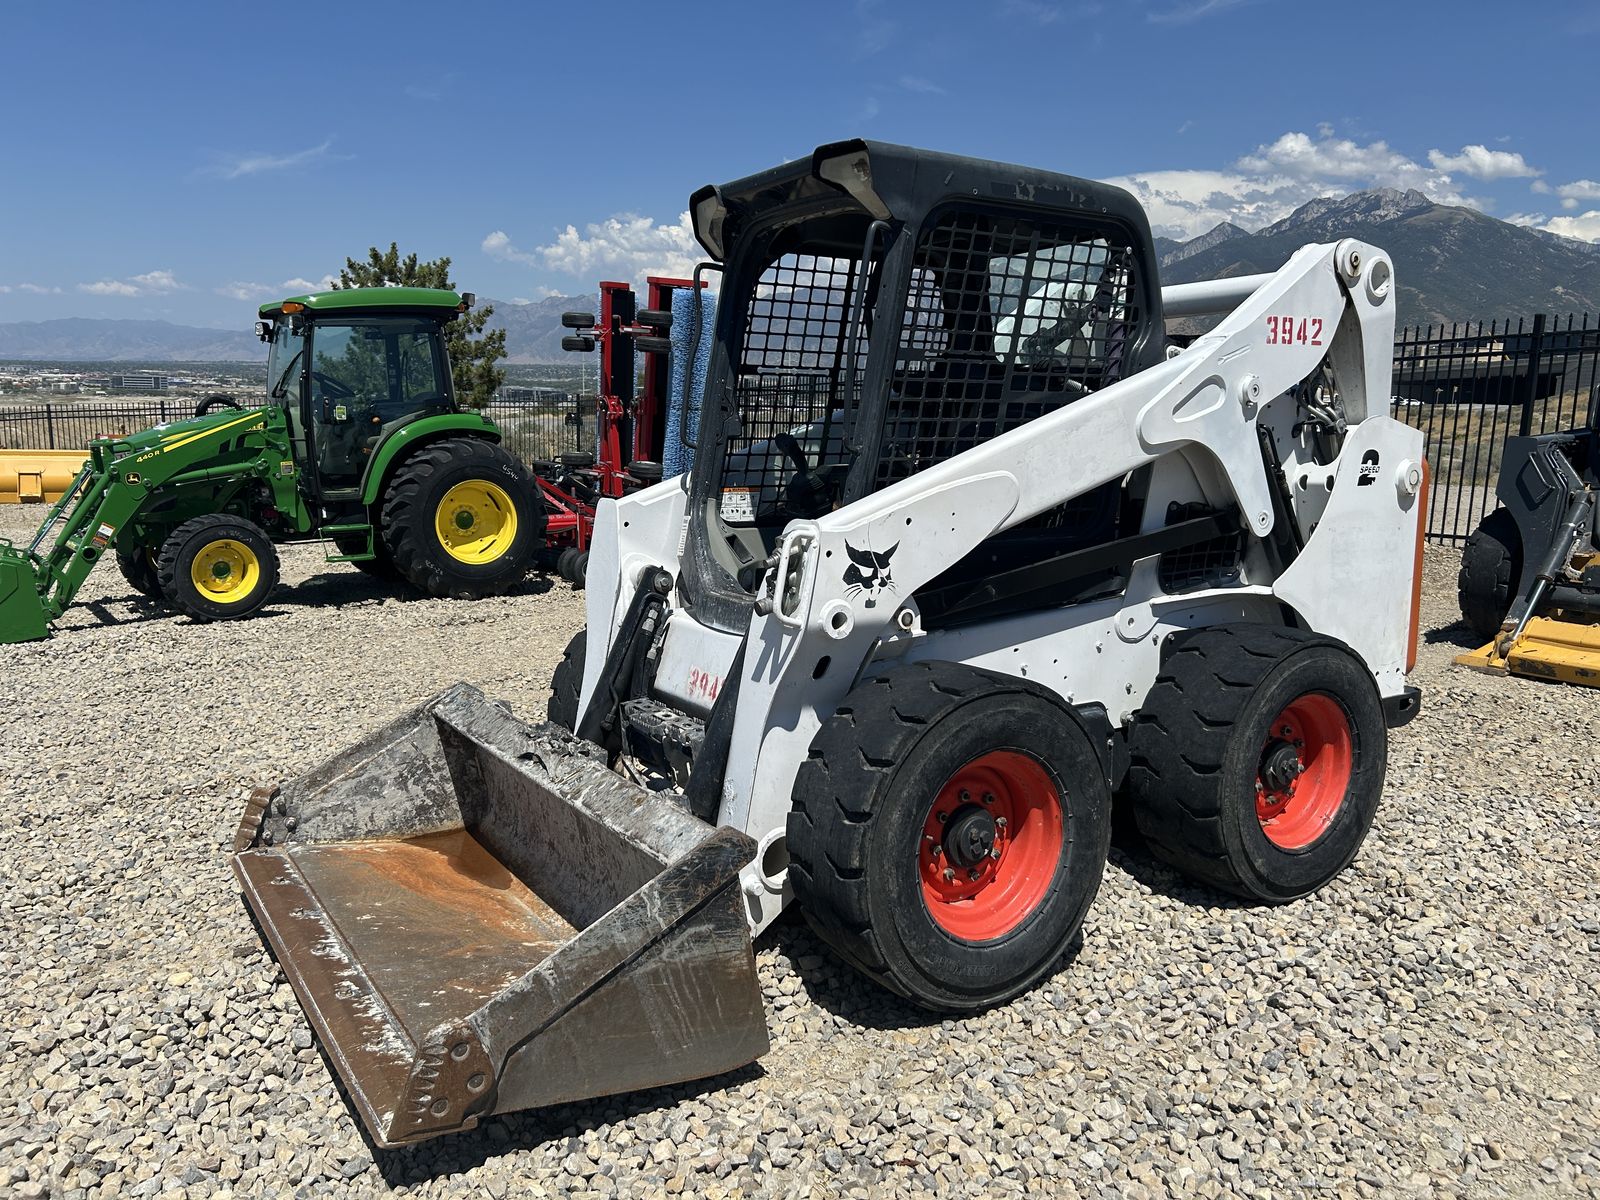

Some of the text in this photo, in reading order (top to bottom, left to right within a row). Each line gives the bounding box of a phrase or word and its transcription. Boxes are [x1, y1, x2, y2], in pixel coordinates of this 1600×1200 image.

[1266, 316, 1322, 346] 3942
[1360, 466, 1380, 474] SPEED
[689, 668, 725, 700] 394
